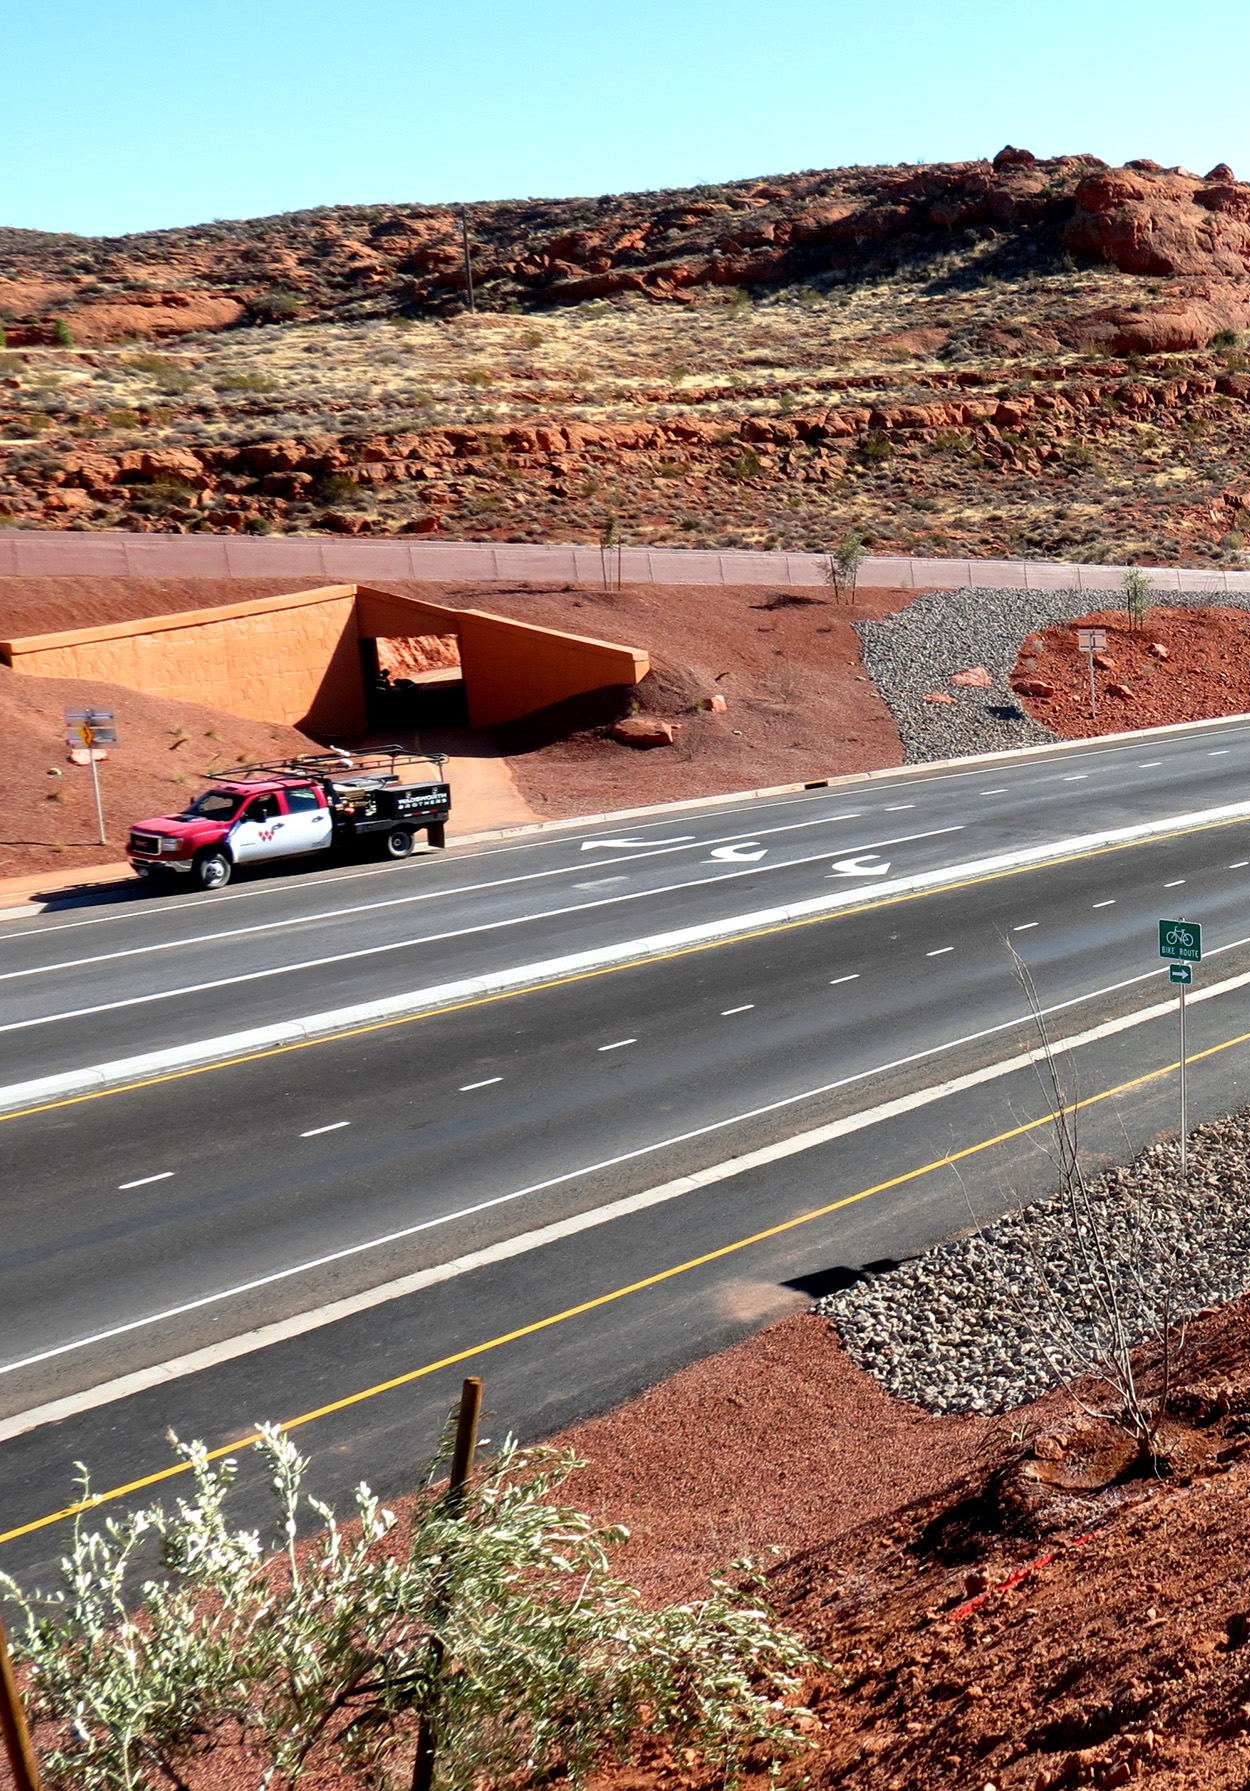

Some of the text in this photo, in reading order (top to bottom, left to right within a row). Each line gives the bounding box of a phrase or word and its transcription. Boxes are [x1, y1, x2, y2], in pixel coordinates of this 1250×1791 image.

[398, 798, 447, 809] BROTHERS
[1161, 945, 1199, 958] BIKE ROUTE
